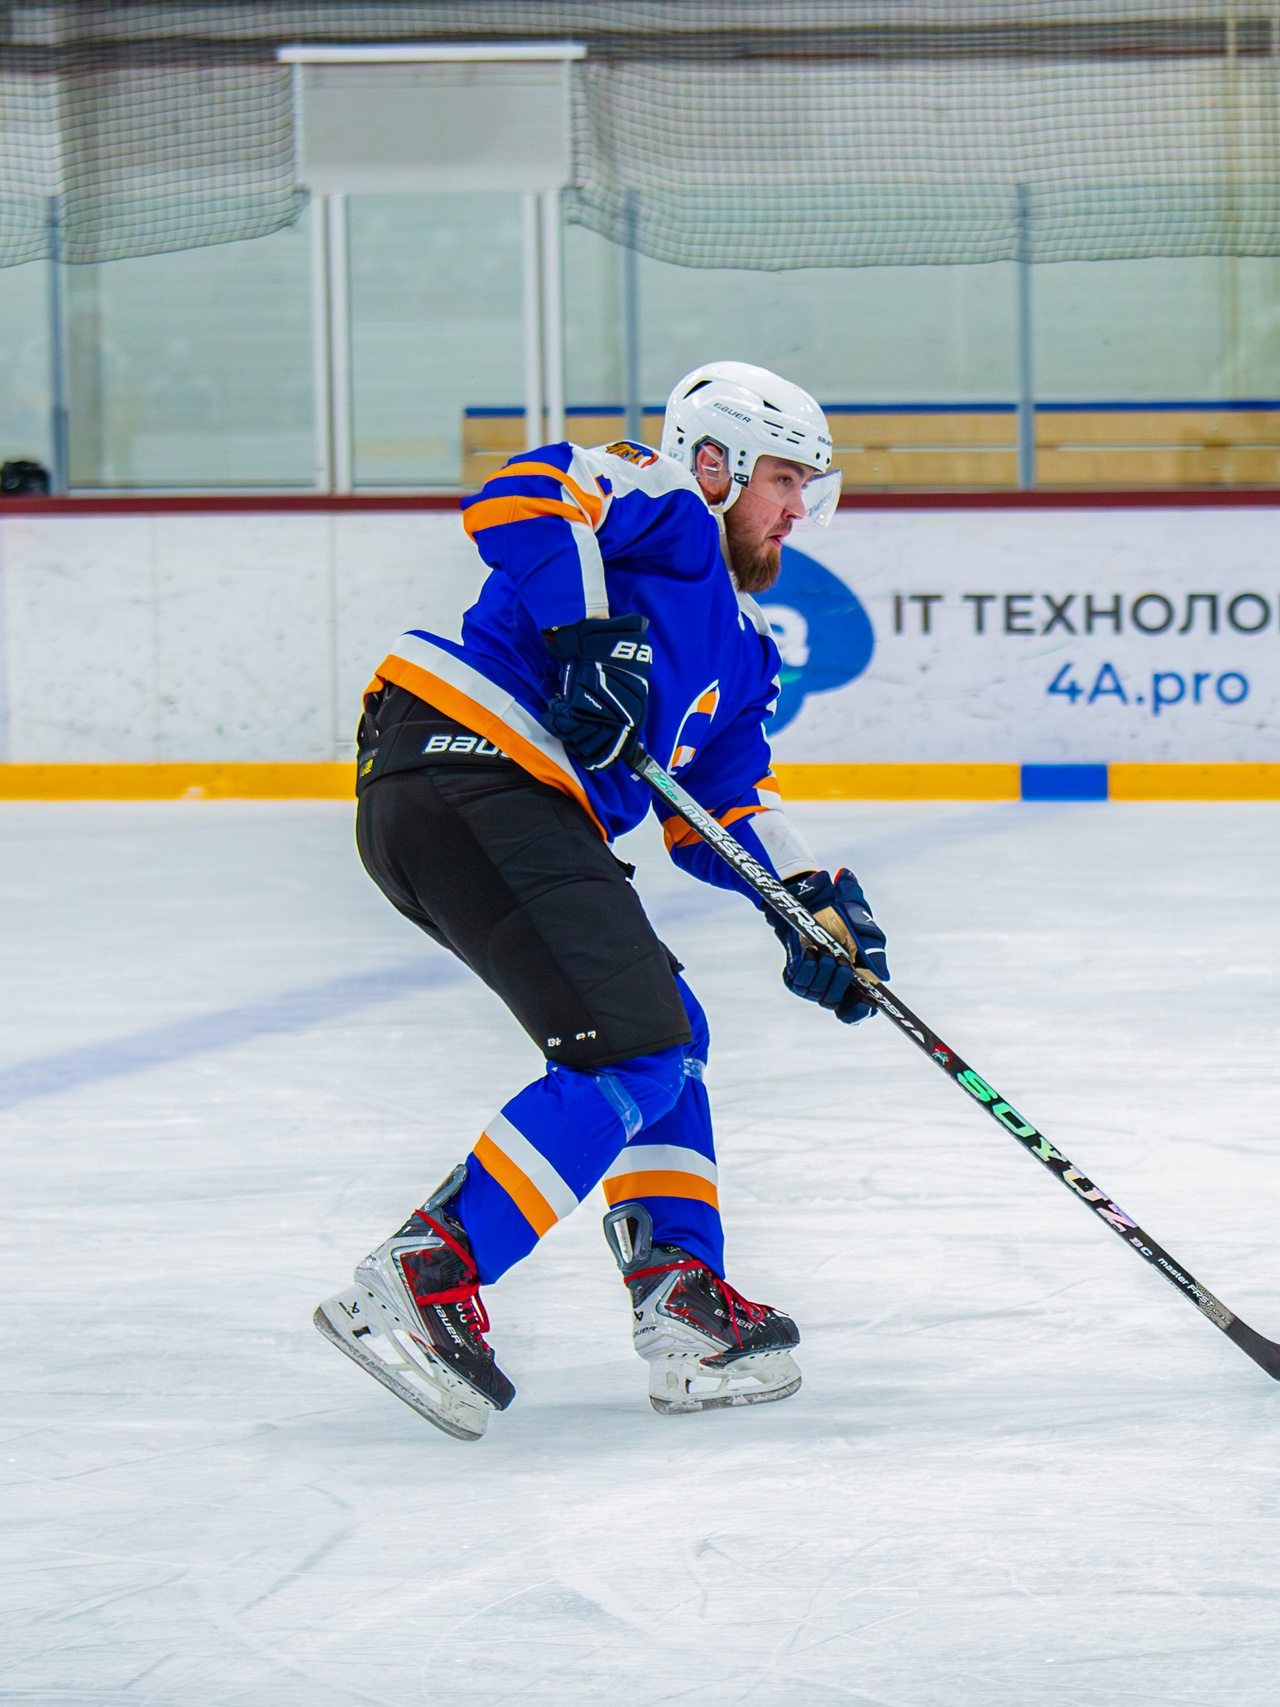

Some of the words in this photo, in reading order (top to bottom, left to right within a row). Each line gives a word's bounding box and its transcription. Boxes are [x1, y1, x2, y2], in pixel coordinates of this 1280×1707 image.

[1046, 662, 1250, 717] 4A.pro
[957, 1069, 1138, 1233] SOYUZ
[1157, 1257, 1190, 1286] master
